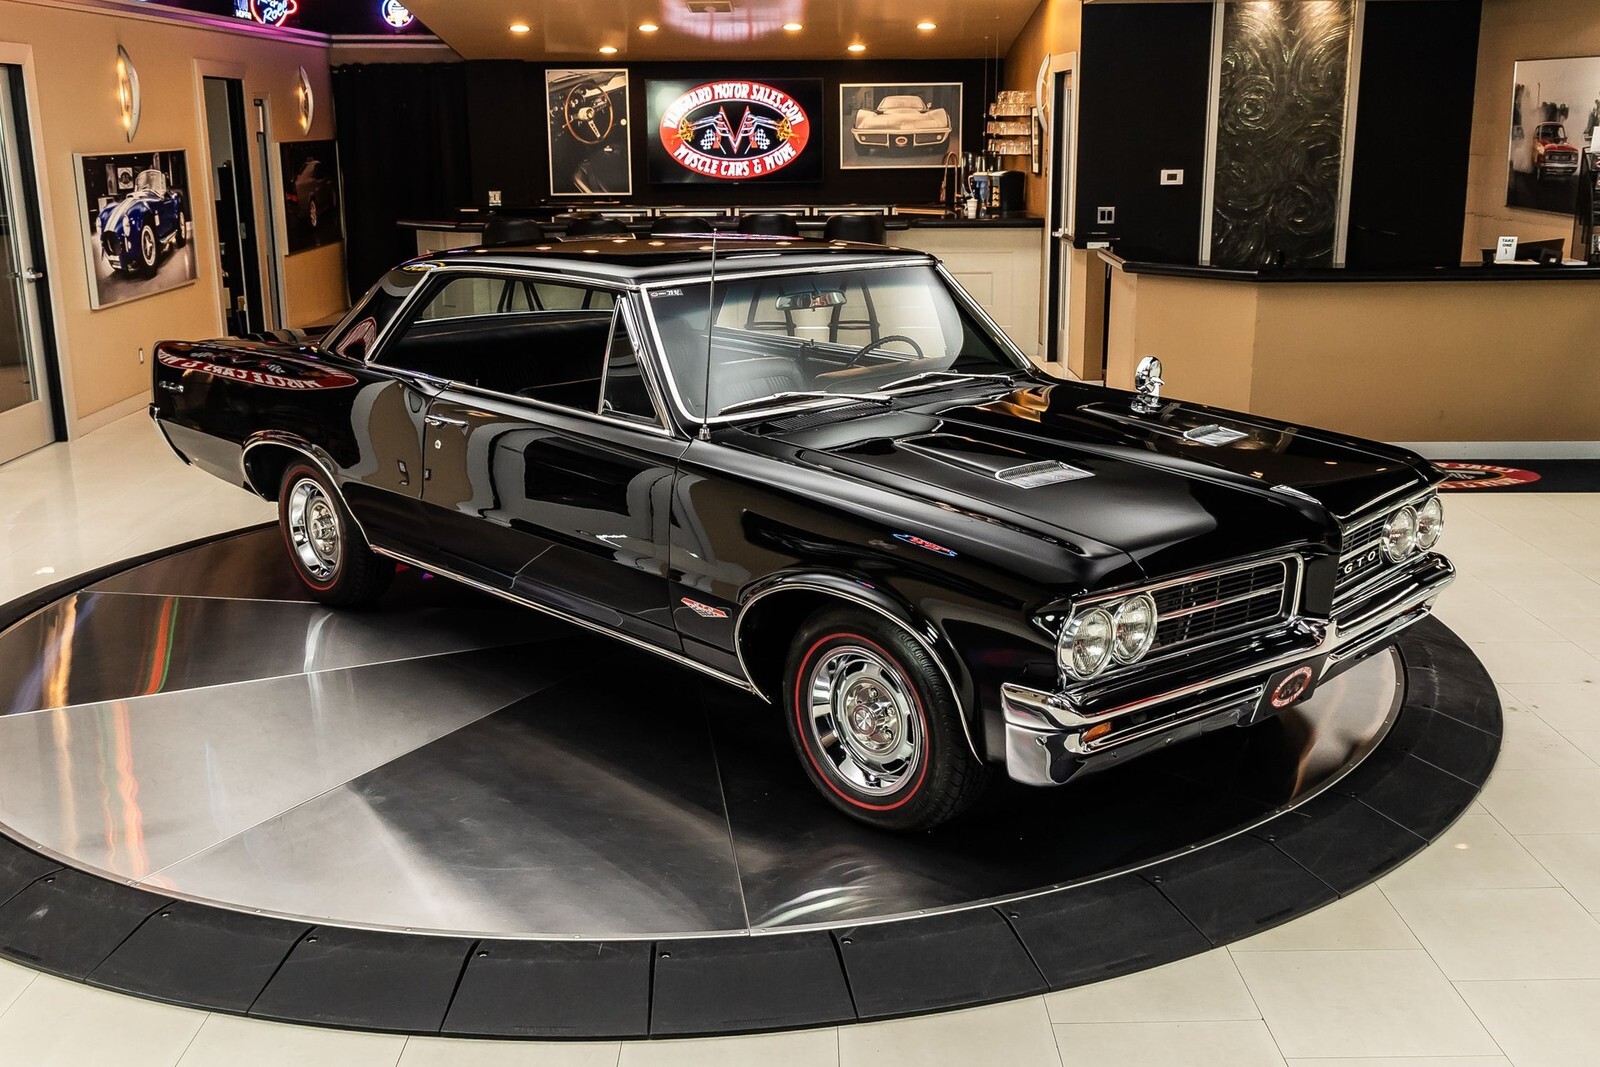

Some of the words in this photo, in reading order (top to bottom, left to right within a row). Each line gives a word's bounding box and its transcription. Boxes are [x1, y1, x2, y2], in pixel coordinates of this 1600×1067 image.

[713, 83, 750, 99] MOTOR
[750, 84, 805, 125] SALES.COM
[673, 144, 720, 175] MUSCLE
[720, 161, 750, 176] CARS
[752, 160, 763, 174] &
[762, 142, 797, 171] MORE
[1344, 550, 1376, 574] GTO
